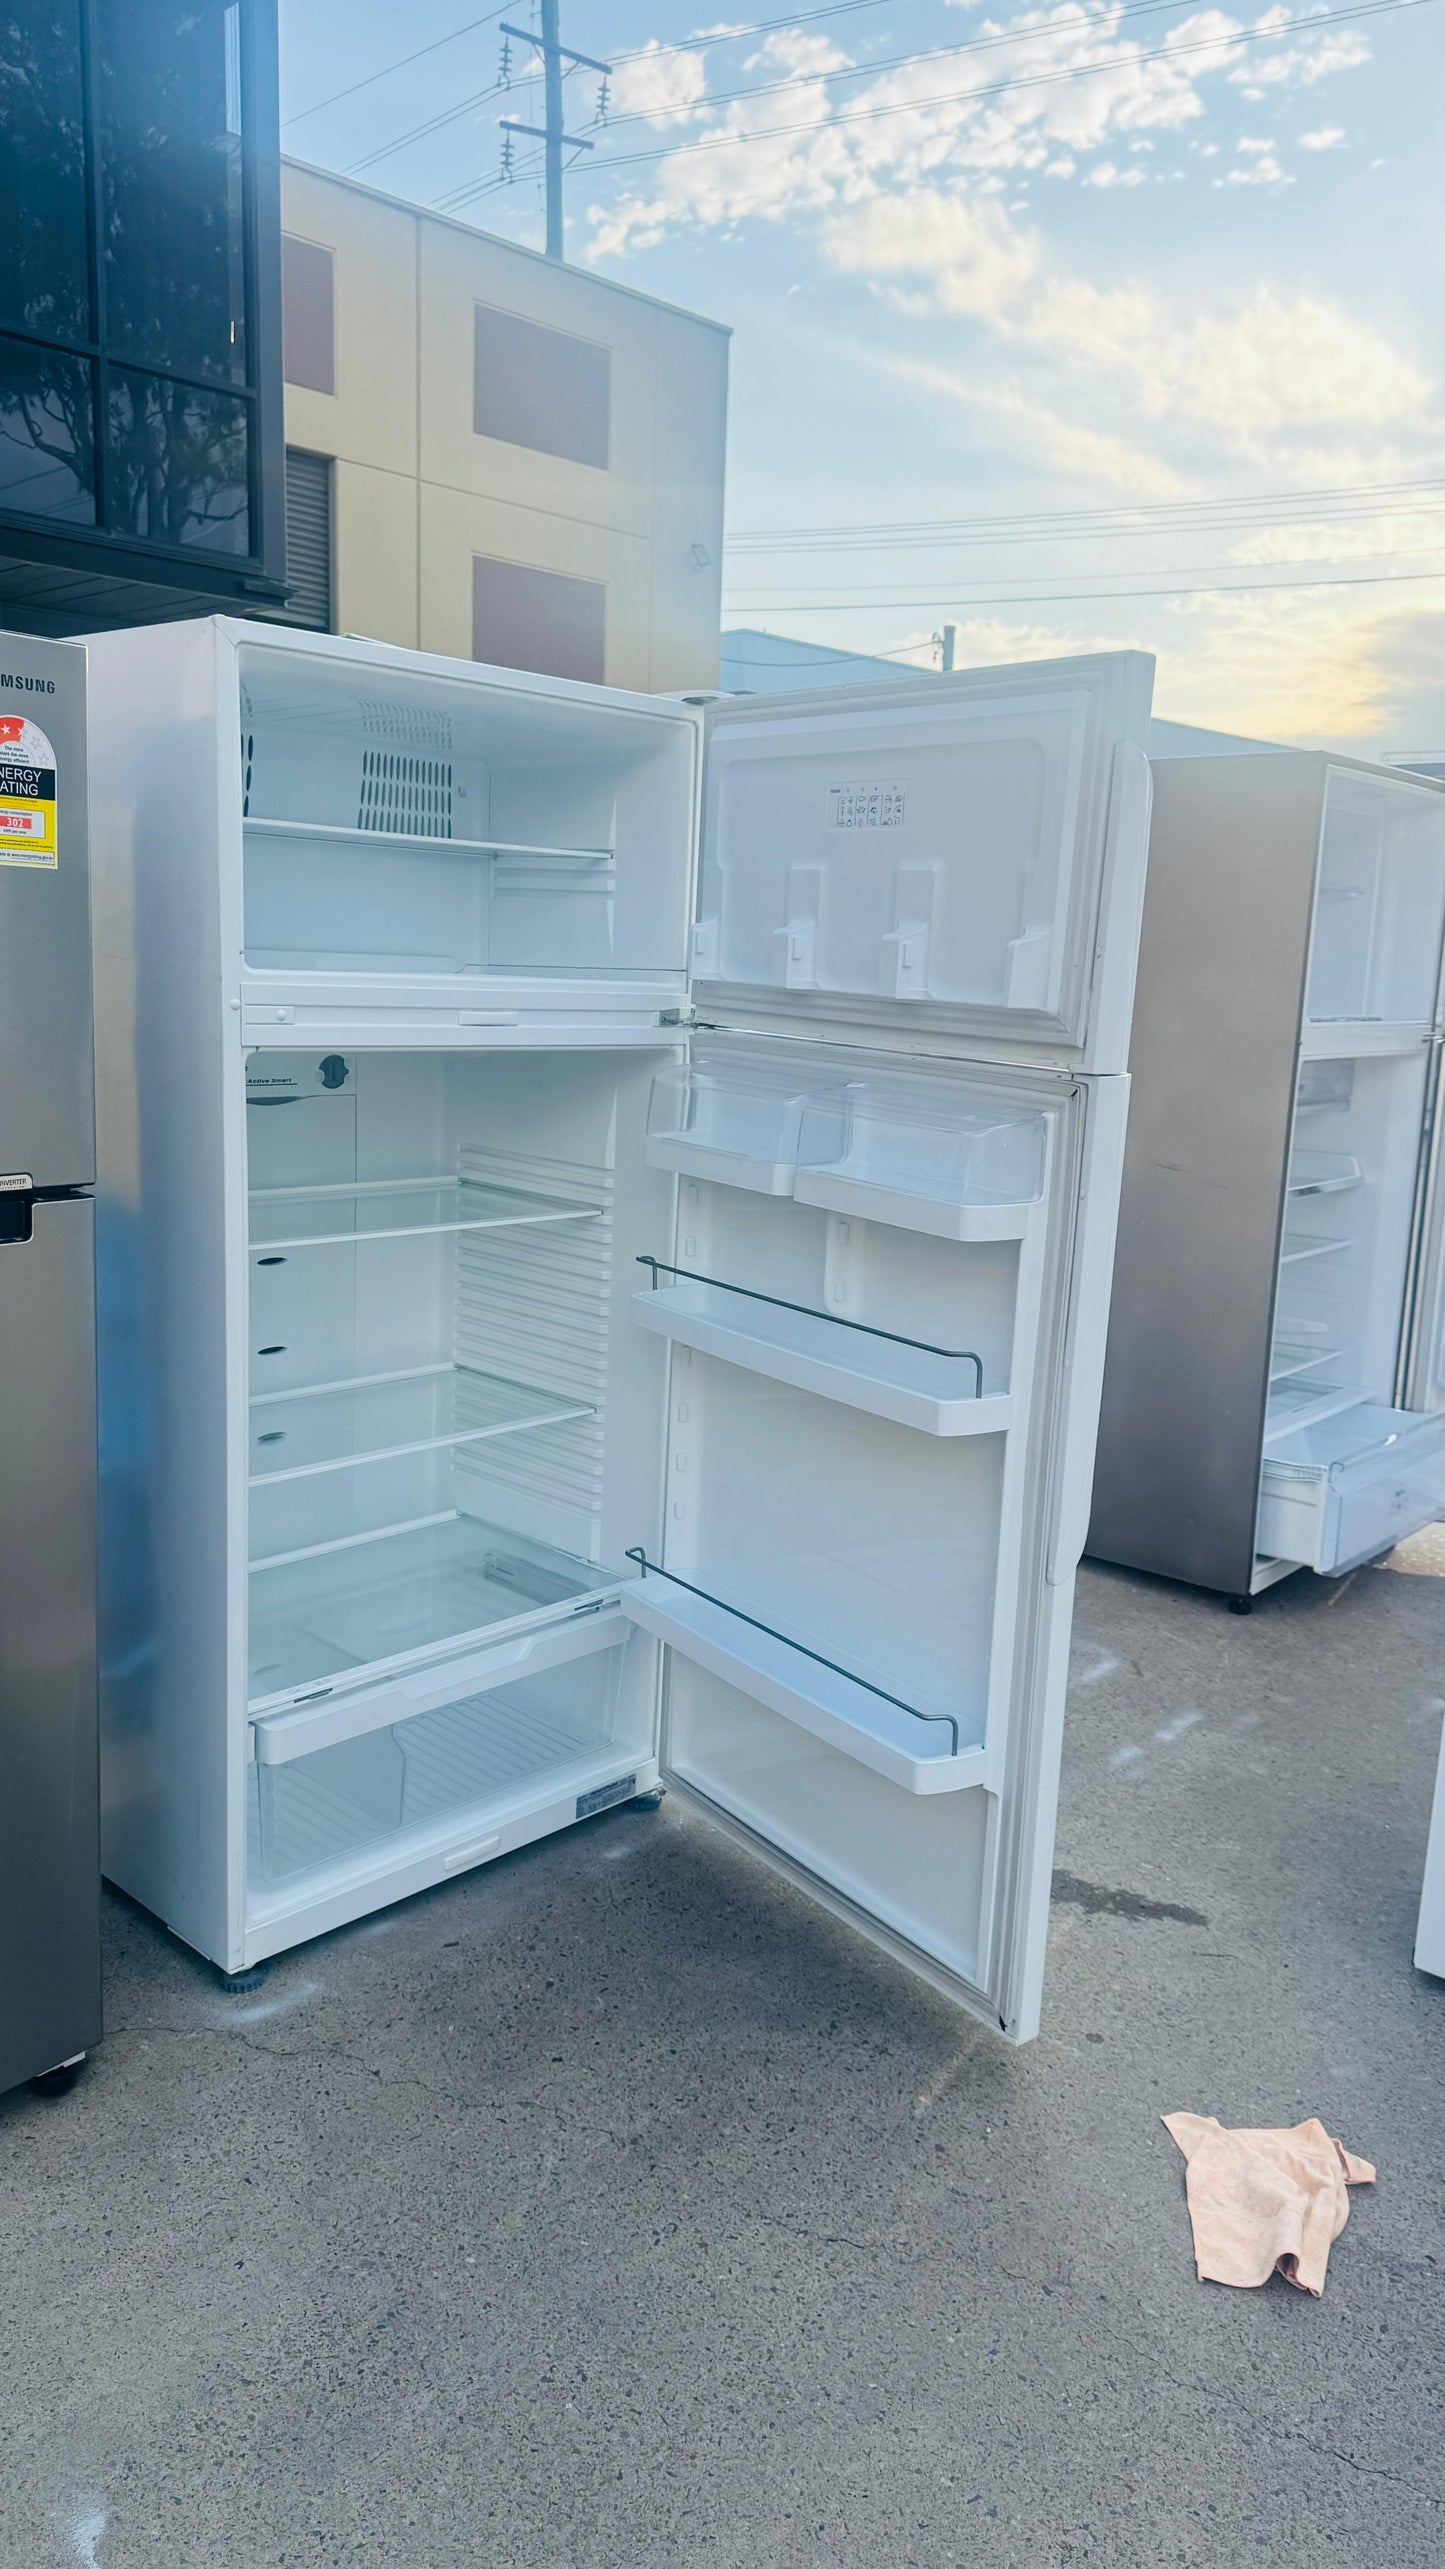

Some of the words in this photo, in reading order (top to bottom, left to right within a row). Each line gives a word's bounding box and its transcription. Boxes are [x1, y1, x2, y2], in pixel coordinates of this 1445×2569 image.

[1, 674, 55, 694] MSUNG
[0, 780, 38, 796] ATING
[7, 818, 23, 828] 302
